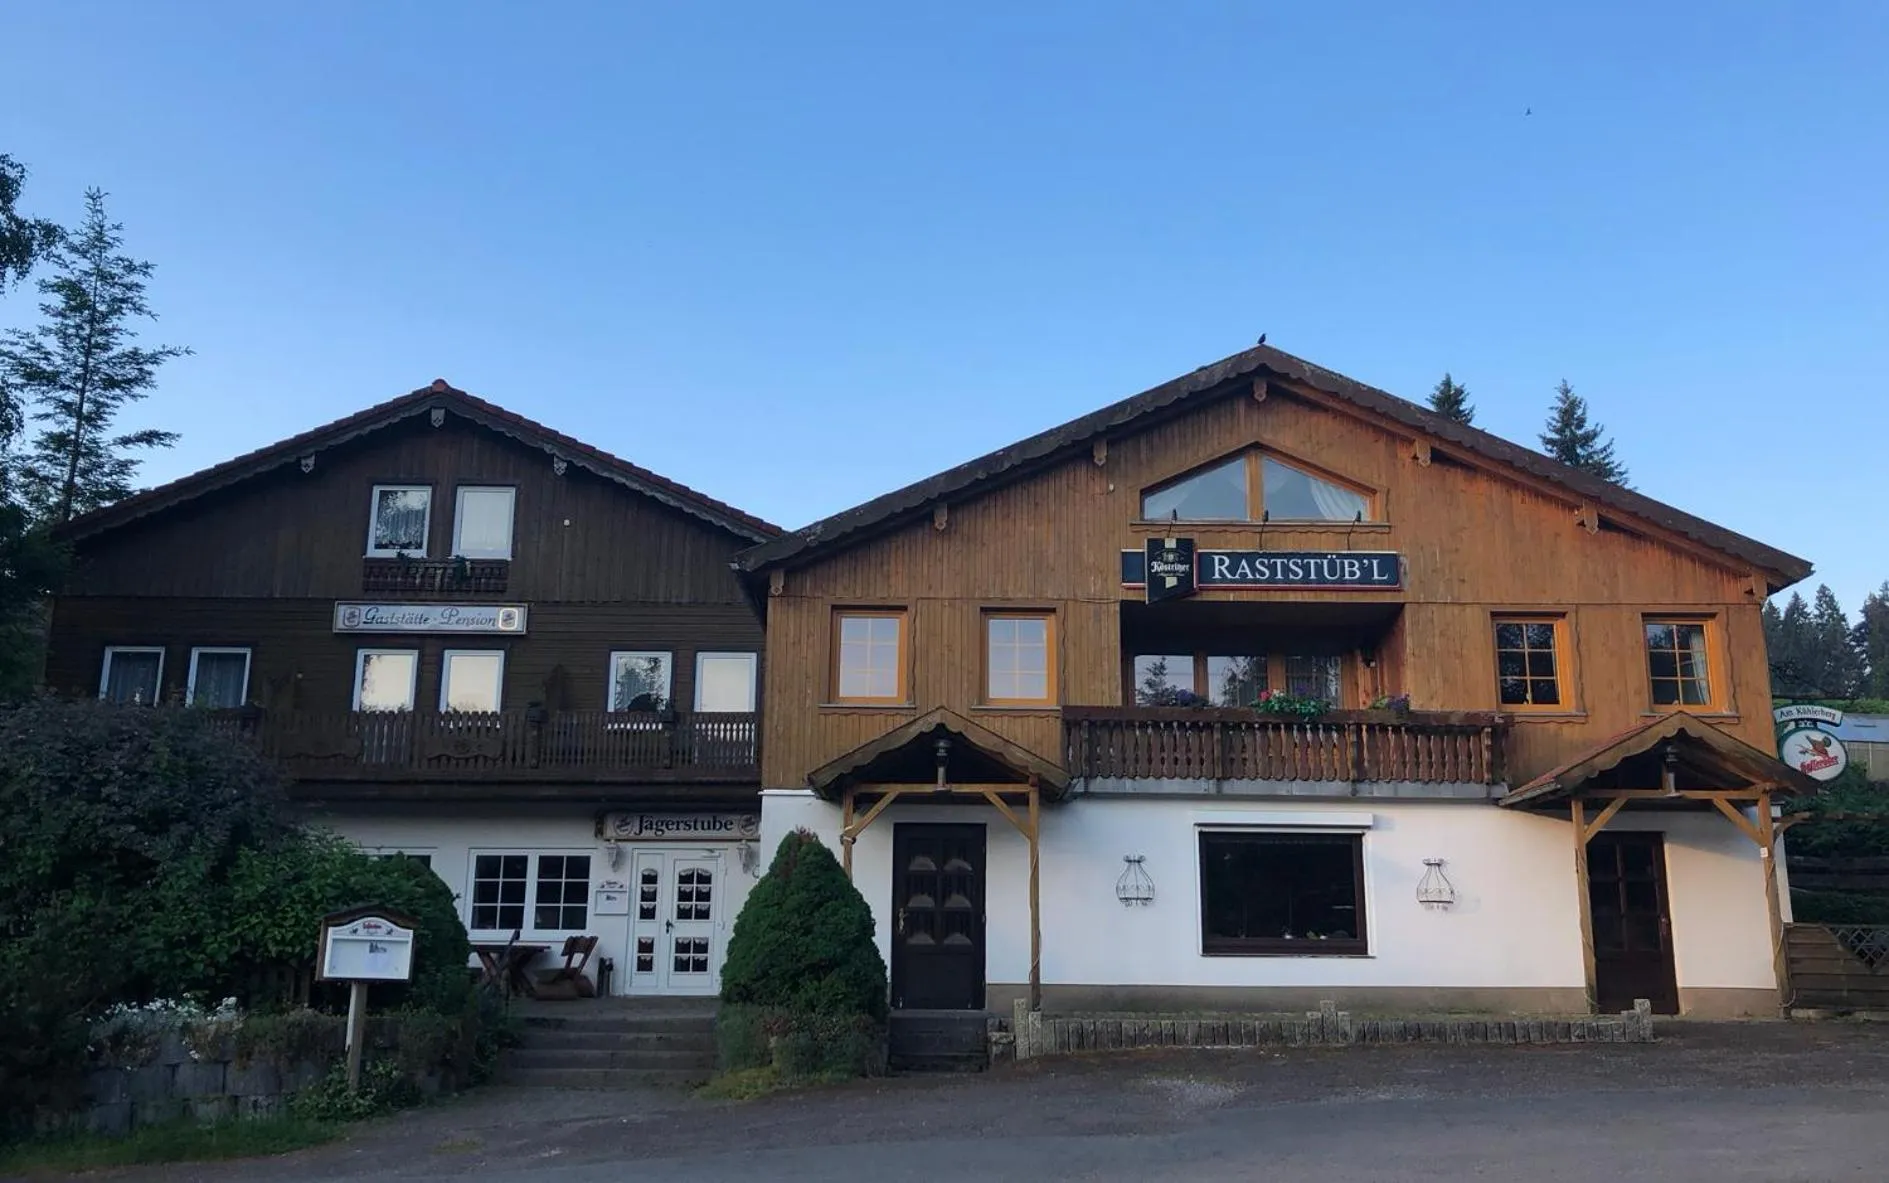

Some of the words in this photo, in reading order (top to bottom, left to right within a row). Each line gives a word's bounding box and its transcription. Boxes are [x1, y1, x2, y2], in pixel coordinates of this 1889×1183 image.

[363, 606, 430, 625] Gaststätte
[441, 607, 496, 627] Pension
[634, 815, 734, 836] Jägerstube
